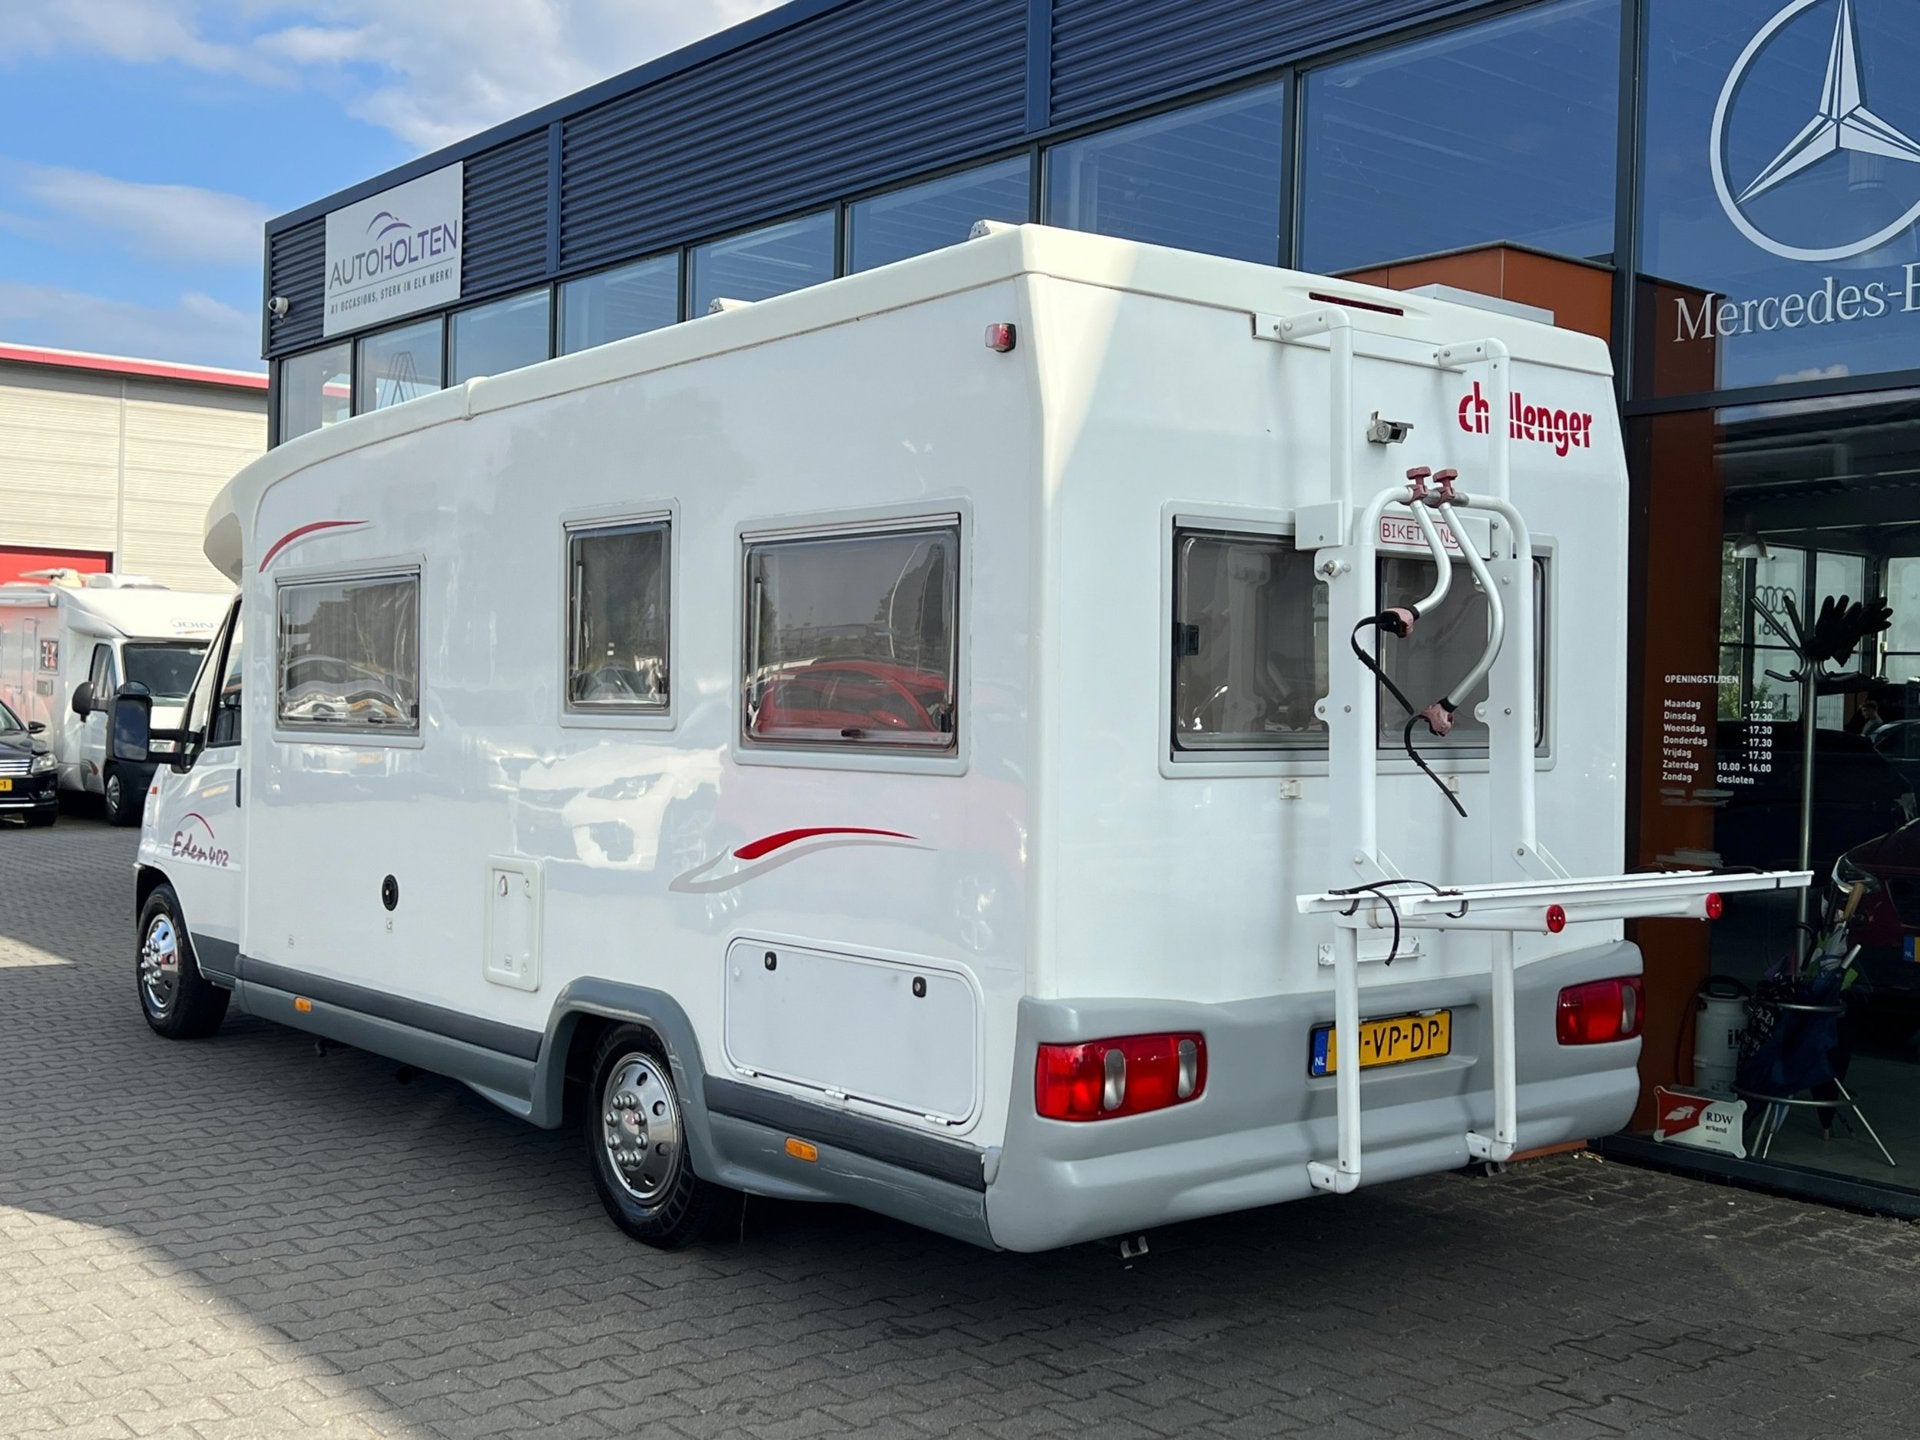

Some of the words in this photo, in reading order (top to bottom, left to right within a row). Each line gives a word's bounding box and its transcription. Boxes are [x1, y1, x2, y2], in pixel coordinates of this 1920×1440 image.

[328, 219, 458, 290] AUTOHOLTEN
[380, 284, 401, 299] STERK
[403, 281, 411, 292] IN
[414, 275, 426, 290] ELK
[1458, 381, 1592, 457] chllenger
[1382, 522, 1458, 544] BIKETNS
[1664, 675, 1739, 684] OPENINGSTIJDEN
[1664, 699, 1701, 710] Maandag
[1750, 700, 1773, 709] 17.30
[1664, 711, 1697, 722] Dinsdag
[1663, 723, 1706, 734] Woensdag
[1749, 726, 1773, 735] 17.30
[1663, 735, 1708, 747] Donderdag
[1749, 738, 1773, 747] 17.30
[1663, 747, 1692, 759] Vrijdag
[1748, 751, 1772, 760] 17.30
[1662, 760, 1699, 771] Zaterdag
[1717, 762, 1740, 771] 10.00
[1662, 772, 1692, 783] Zondag
[1716, 775, 1755, 785] Gesloten
[171, 830, 208, 862] Eden
[208, 846, 229, 867] 402
[1358, 1020, 1440, 1058] -VP-DP
[1314, 1056, 1325, 1067] NL
[1706, 1111, 1734, 1125] RDW
